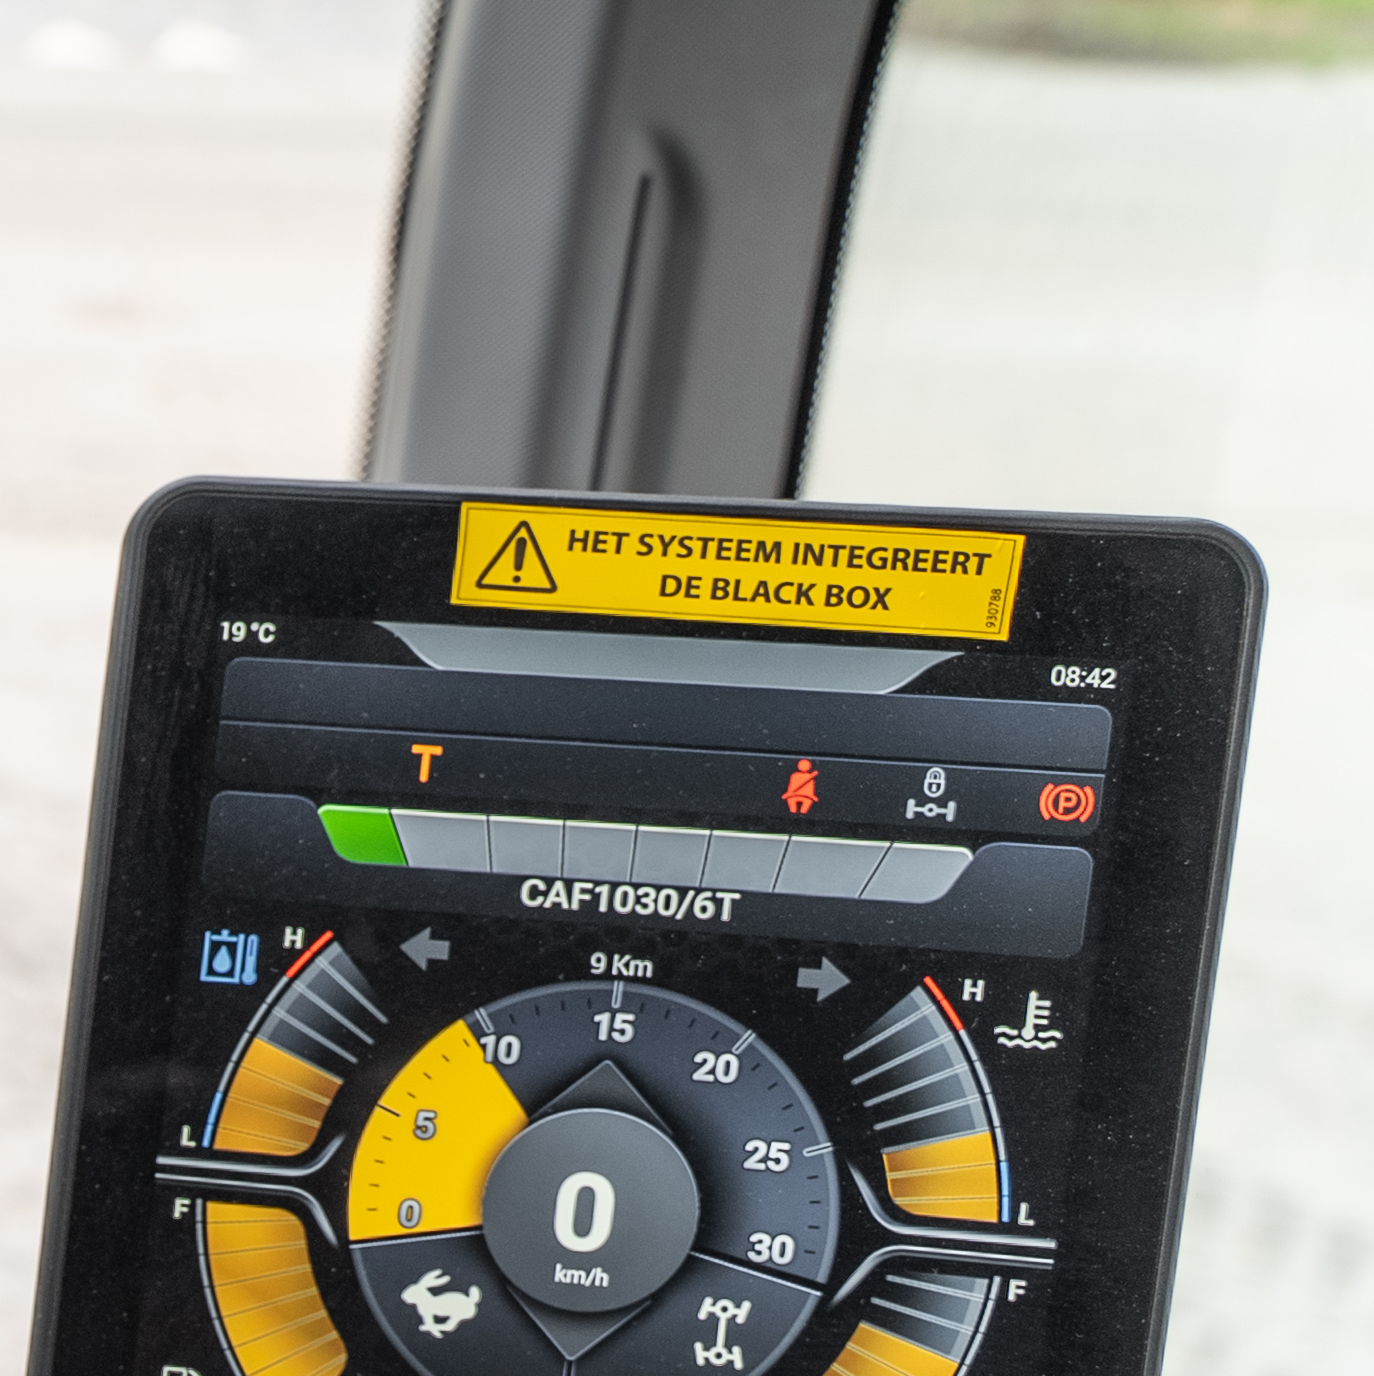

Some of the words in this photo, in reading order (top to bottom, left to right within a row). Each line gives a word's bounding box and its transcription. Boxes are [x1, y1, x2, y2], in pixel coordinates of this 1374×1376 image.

[567, 530, 629, 555] HET
[636, 533, 782, 564] SYSTEEM
[791, 541, 992, 576] INTEGREERT
[659, 574, 701, 598] DE
[710, 578, 813, 606] BLACK
[824, 583, 892, 611] BOX
[985, 588, 1002, 629] 930788
[1050, 665, 1117, 689] 08:42
[411, 744, 443, 783] T
[519, 878, 742, 922] CAF1030/6T
[283, 927, 304, 949] H
[590, 951, 608, 975] 9
[611, 953, 653, 978] Km
[962, 978, 985, 1002] H
[593, 1011, 637, 1043] 15
[479, 1033, 521, 1065] 10
[691, 1050, 740, 1084] 20
[180, 1126, 196, 1148] L
[413, 1109, 437, 1141] 5
[742, 1138, 792, 1172] 25
[172, 1198, 191, 1220] F
[398, 1198, 422, 1229] 0
[552, 1170, 617, 1253] 0
[1018, 1202, 1035, 1226] L
[746, 1231, 796, 1265] 30
[553, 1263, 610, 1289] km/h
[1007, 1278, 1028, 1302] F
